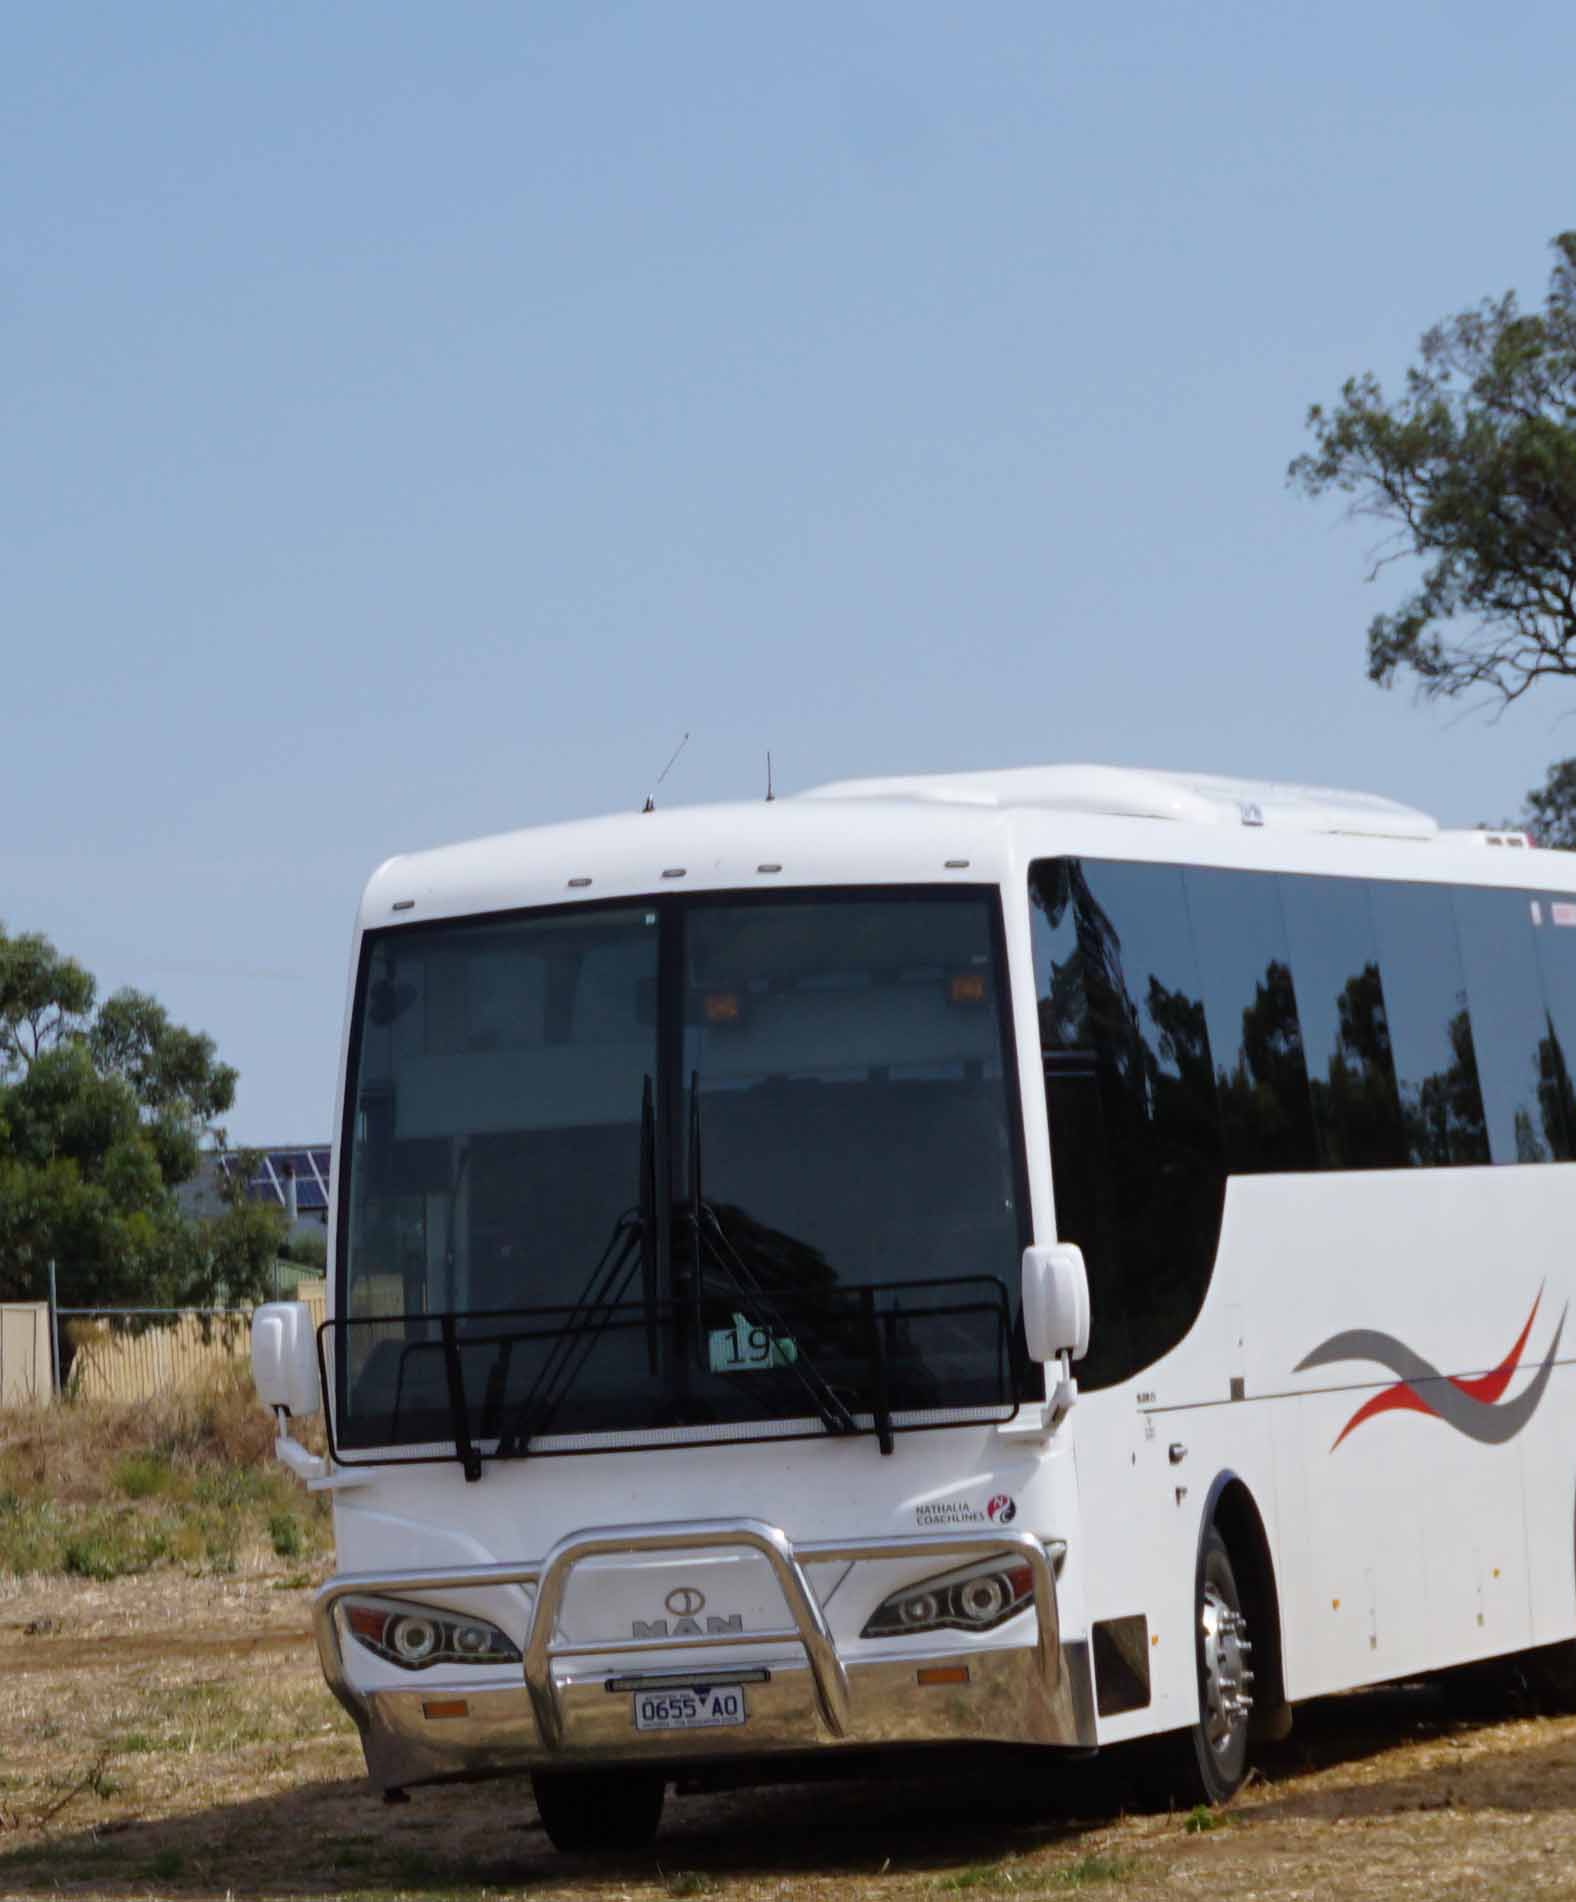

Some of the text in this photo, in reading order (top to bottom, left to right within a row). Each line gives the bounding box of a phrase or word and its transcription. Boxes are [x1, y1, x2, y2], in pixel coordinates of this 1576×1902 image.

[725, 1327, 770, 1363] 19
[915, 1501, 970, 1515] NATHALIA
[915, 1512, 985, 1527] COACHLINES
[631, 1613, 744, 1639] MAN
[642, 1698, 697, 1722] 0655
